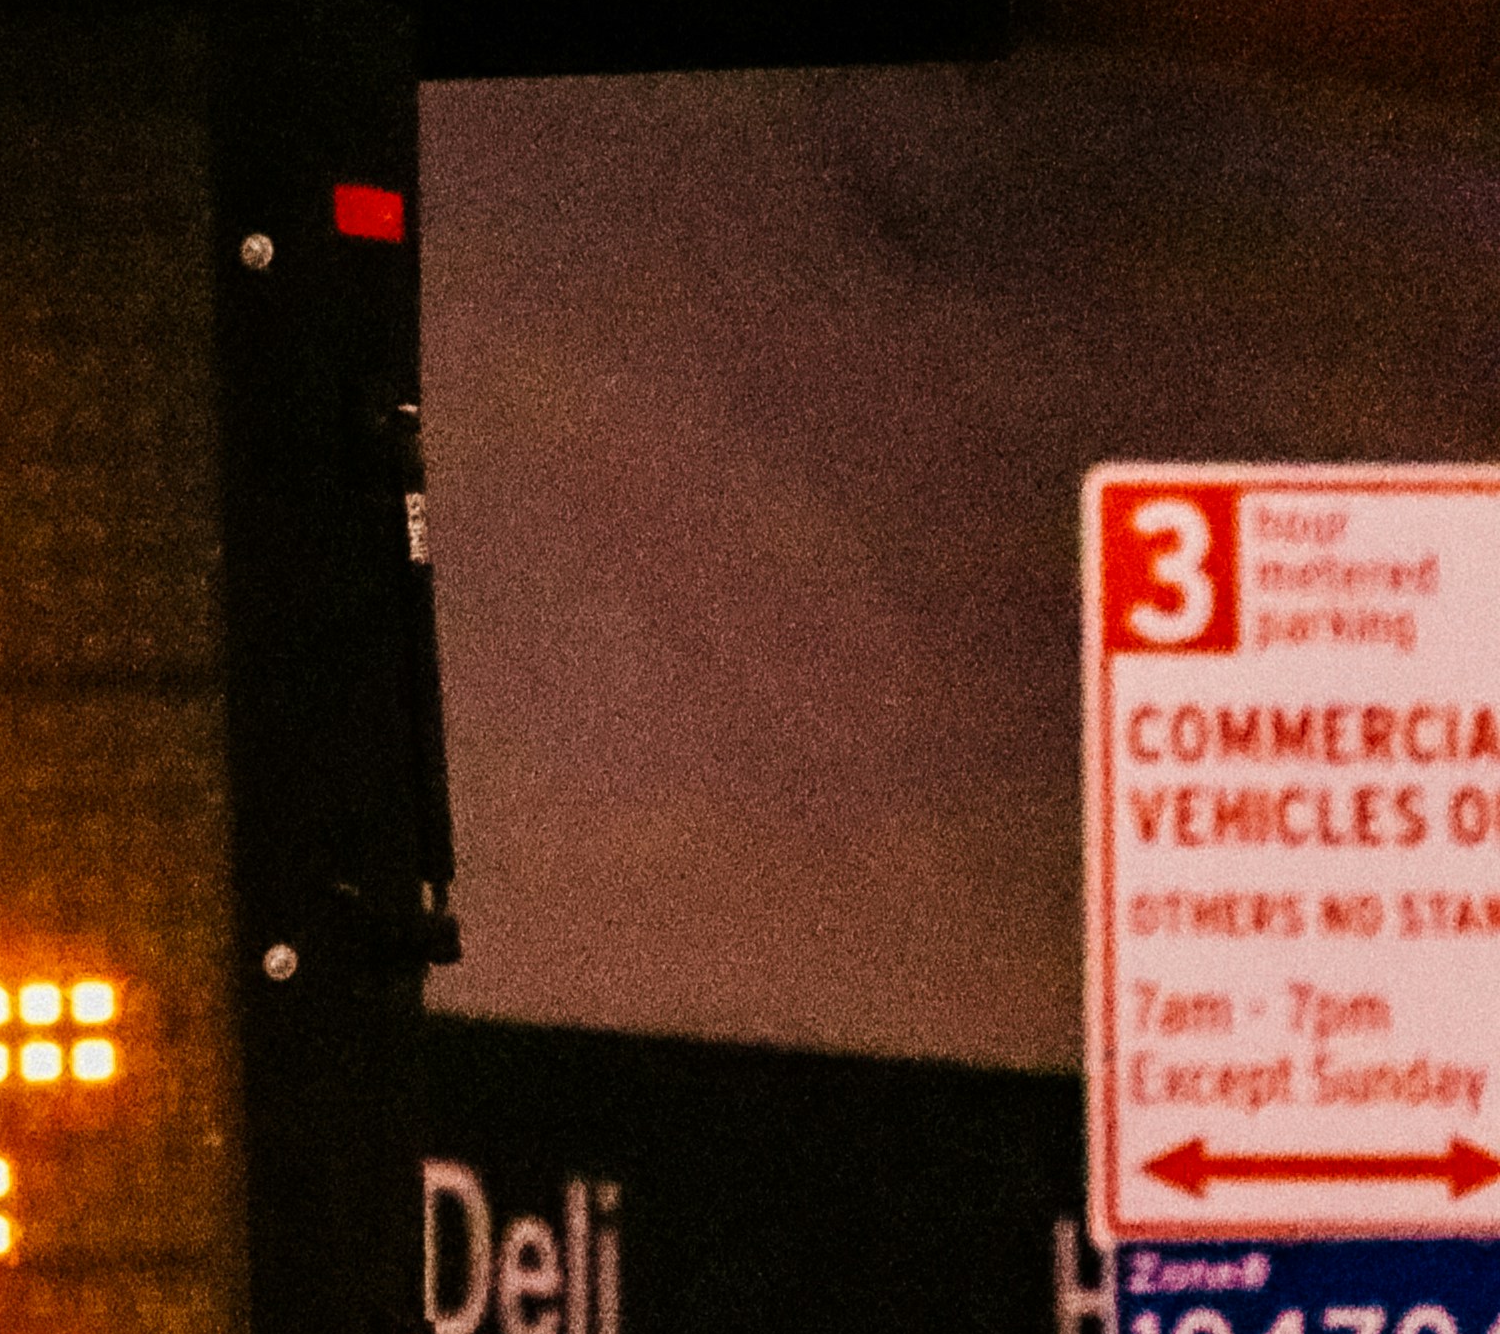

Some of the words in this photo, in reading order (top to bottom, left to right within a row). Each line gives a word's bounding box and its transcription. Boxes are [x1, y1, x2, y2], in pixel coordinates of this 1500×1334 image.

[1129, 497, 1214, 645] 3
[1256, 610, 1418, 652] parking
[1128, 782, 1429, 848] VEHICLES
[1448, 783, 1500, 848] O
[1129, 891, 1305, 940] OTHERS
[1318, 892, 1385, 940] NO
[1131, 977, 1234, 1035] 7am
[1288, 977, 1393, 1041] 7pm
[1131, 1050, 1293, 1116] Except
[1312, 1051, 1488, 1117] Sunday
